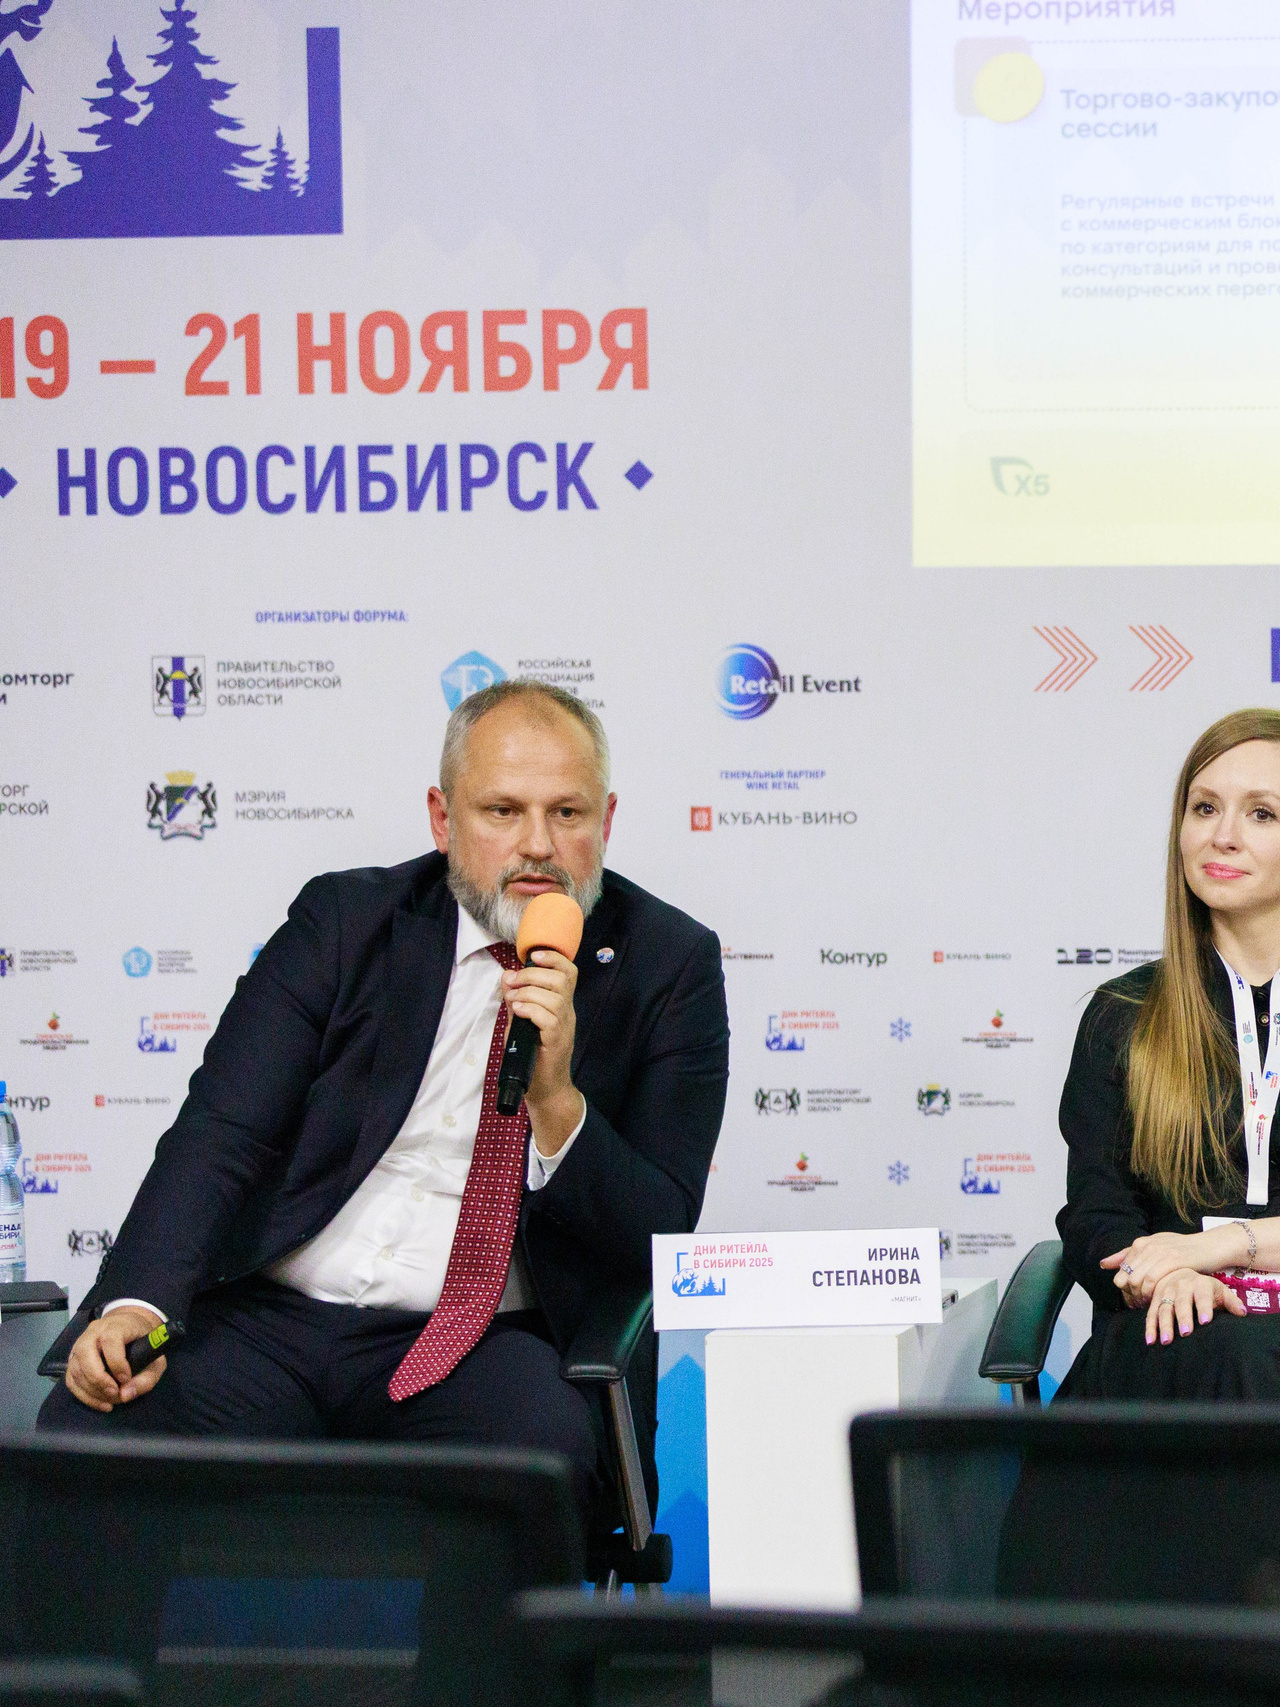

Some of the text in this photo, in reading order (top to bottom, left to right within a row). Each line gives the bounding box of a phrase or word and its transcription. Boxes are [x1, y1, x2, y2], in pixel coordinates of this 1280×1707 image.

[958, 0, 1175, 24] Мероприятия
[1061, 121, 1158, 139] сессии
[1061, 193, 1275, 213] Регулярные встречи
[1060, 220, 1072, 232] с
[1078, 217, 1232, 234] коммерческим
[1060, 242, 1086, 255] по
[1091, 240, 1210, 256] категориям
[1216, 239, 1253, 254] для
[1061, 259, 1202, 280] консультаций
[1208, 262, 1221, 274] и
[1061, 284, 1211, 301] коммерческих
[0, 315, 70, 399] 19
[185, 312, 261, 396] 21
[296, 308, 648, 394] НОЯБРЯ
[57, 442, 598, 516] НОВОСИБИРСК
[1014, 474, 1050, 496] X5
[255, 610, 408, 623] ОРГАНИЗАТОРЫ ФОРУМА:
[216, 660, 335, 673] ПРАВИТЕЛЬСТВО
[518, 658, 591, 669] РОССИЙСКАЯ
[0, 674, 73, 688] омторг
[217, 676, 341, 689] НОВОСИБИРСКОЙ
[731, 675, 860, 694] Retail Event
[217, 694, 282, 706] ОБЛАСТИ
[720, 770, 825, 781] ГЕНЕРАЛЬНЫЙ ПАРТНЕР
[746, 782, 800, 790] WINE RETAIL
[235, 791, 286, 803] МЭРИЯ
[235, 808, 354, 820] НОВОСИБИРСКА
[718, 811, 858, 825] КУБАНЬ-ВИНО
[820, 949, 888, 967] Контур
[694, 1242, 768, 1256] ДНИ РИТЕЙЛА
[868, 1247, 919, 1261] ИРИНА
[703, 1258, 746, 1268] СИБИРИ
[749, 1258, 773, 1267] 2025
[812, 1268, 921, 1287] СТЕПАНОВА
